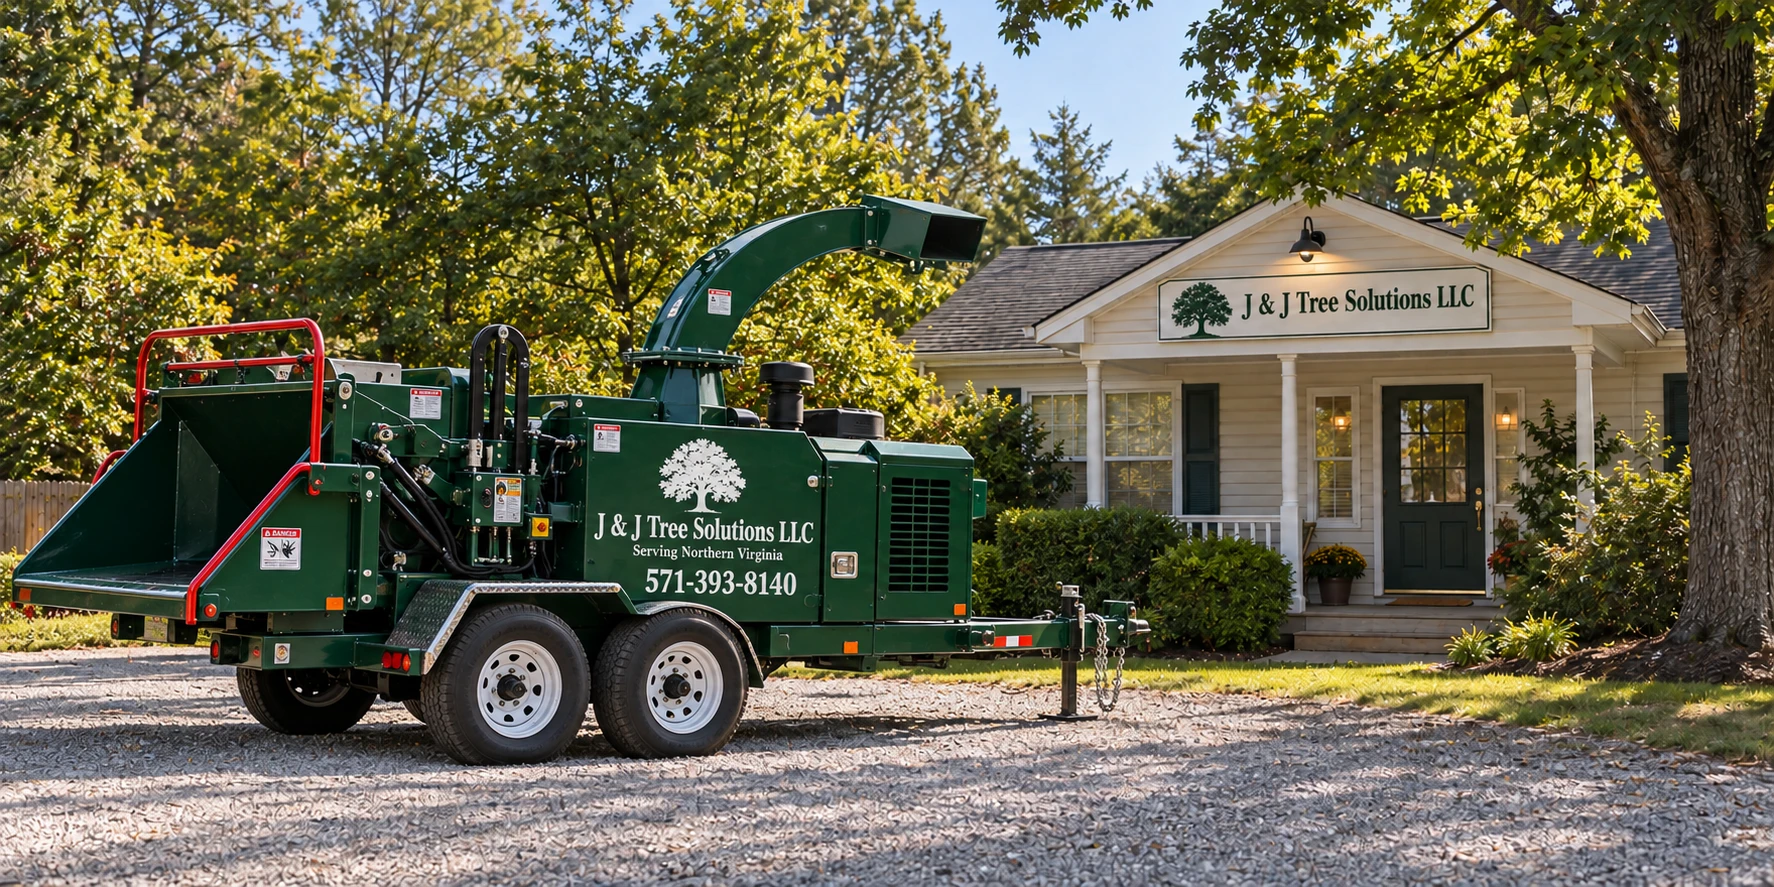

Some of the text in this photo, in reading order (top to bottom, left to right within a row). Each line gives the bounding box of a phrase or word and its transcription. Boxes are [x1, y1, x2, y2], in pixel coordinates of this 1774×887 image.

[1241, 284, 1475, 320] J & J Tree Solutions LLC
[594, 512, 814, 544] J & J Tree Solutions LLC
[633, 543, 784, 564] Serving Northern Virginia
[645, 568, 797, 596] 571-393-8140
